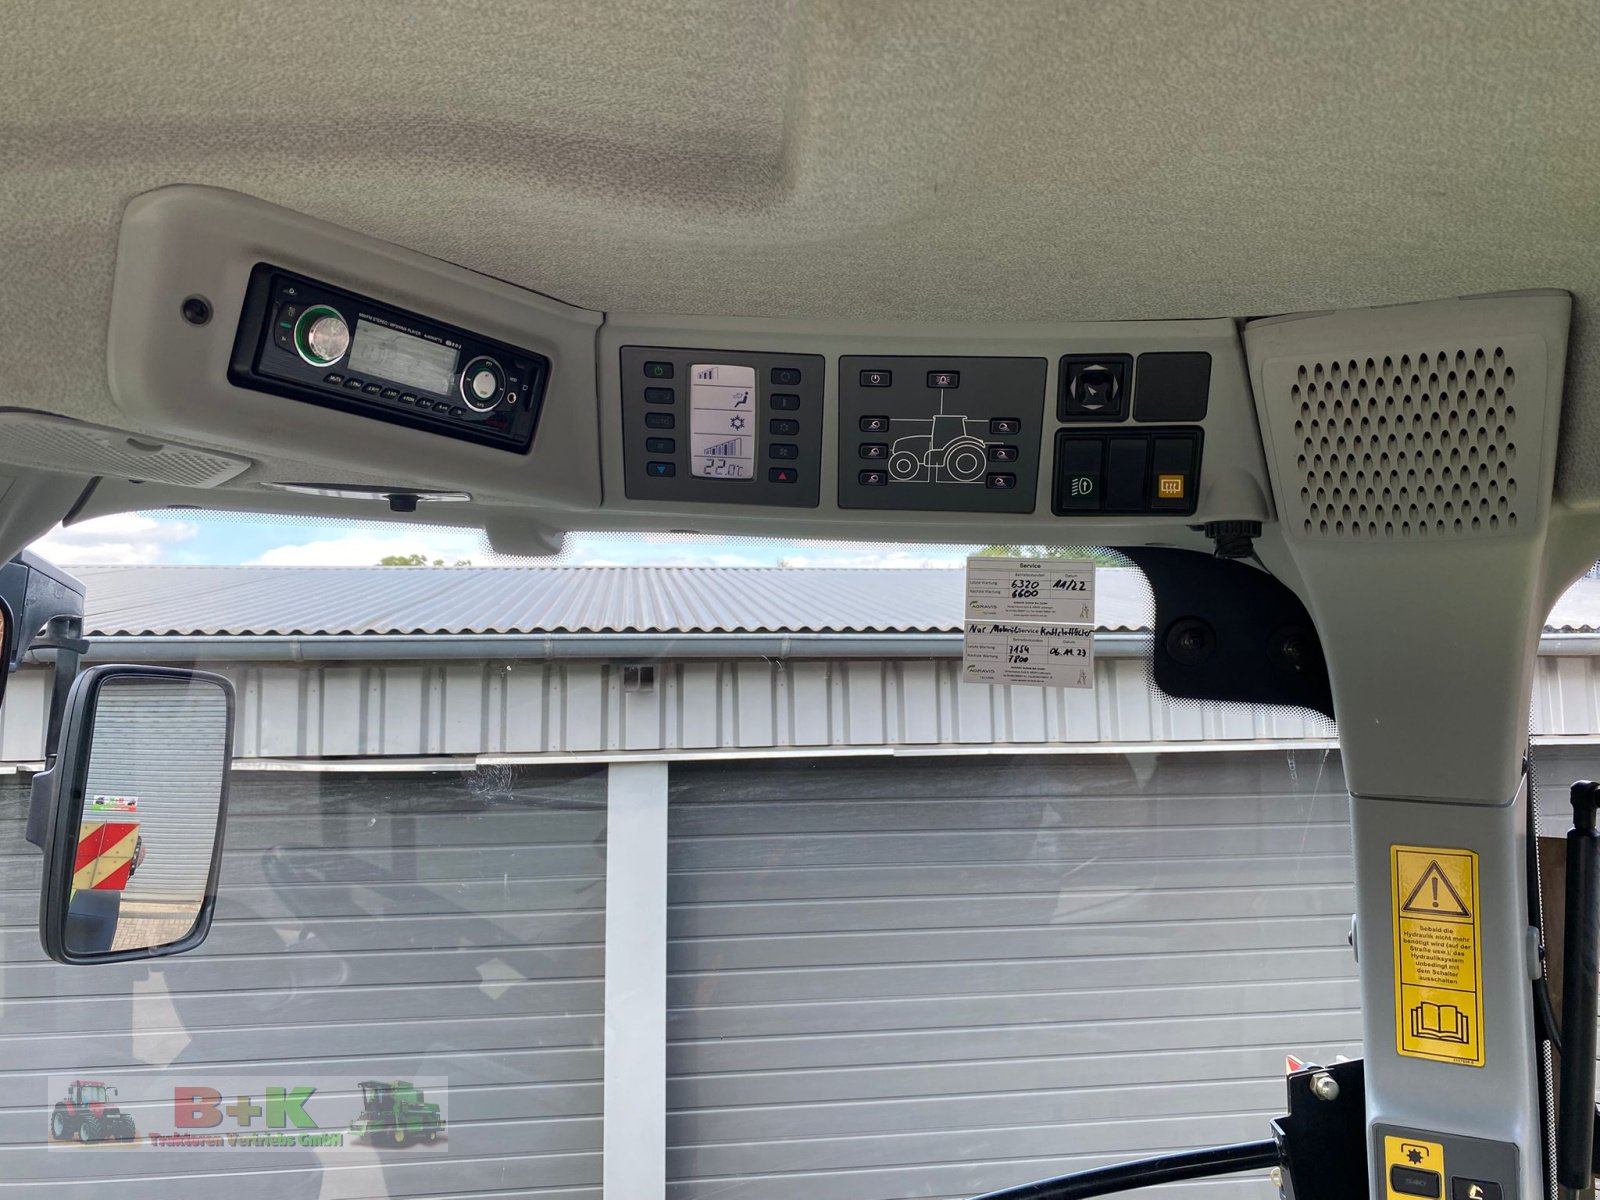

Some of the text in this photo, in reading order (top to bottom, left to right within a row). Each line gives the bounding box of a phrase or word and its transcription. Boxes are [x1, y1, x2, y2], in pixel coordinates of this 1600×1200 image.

[1011, 580, 1040, 589] 6320
[1052, 579, 1086, 591] 11/22
[1012, 589, 1039, 598] 6600
[968, 624, 986, 634] Nur
[1008, 644, 1030, 654] 7154
[1008, 655, 1029, 664] 7800
[1404, 930, 1434, 938] Hydraulik
[1403, 938, 1430, 946] benötigt
[1410, 952, 1464, 963] Hydrauliksystem
[1416, 961, 1448, 970] unbedingt
[1432, 969, 1458, 977] Schalter
[1420, 976, 1458, 984] ausschalten
